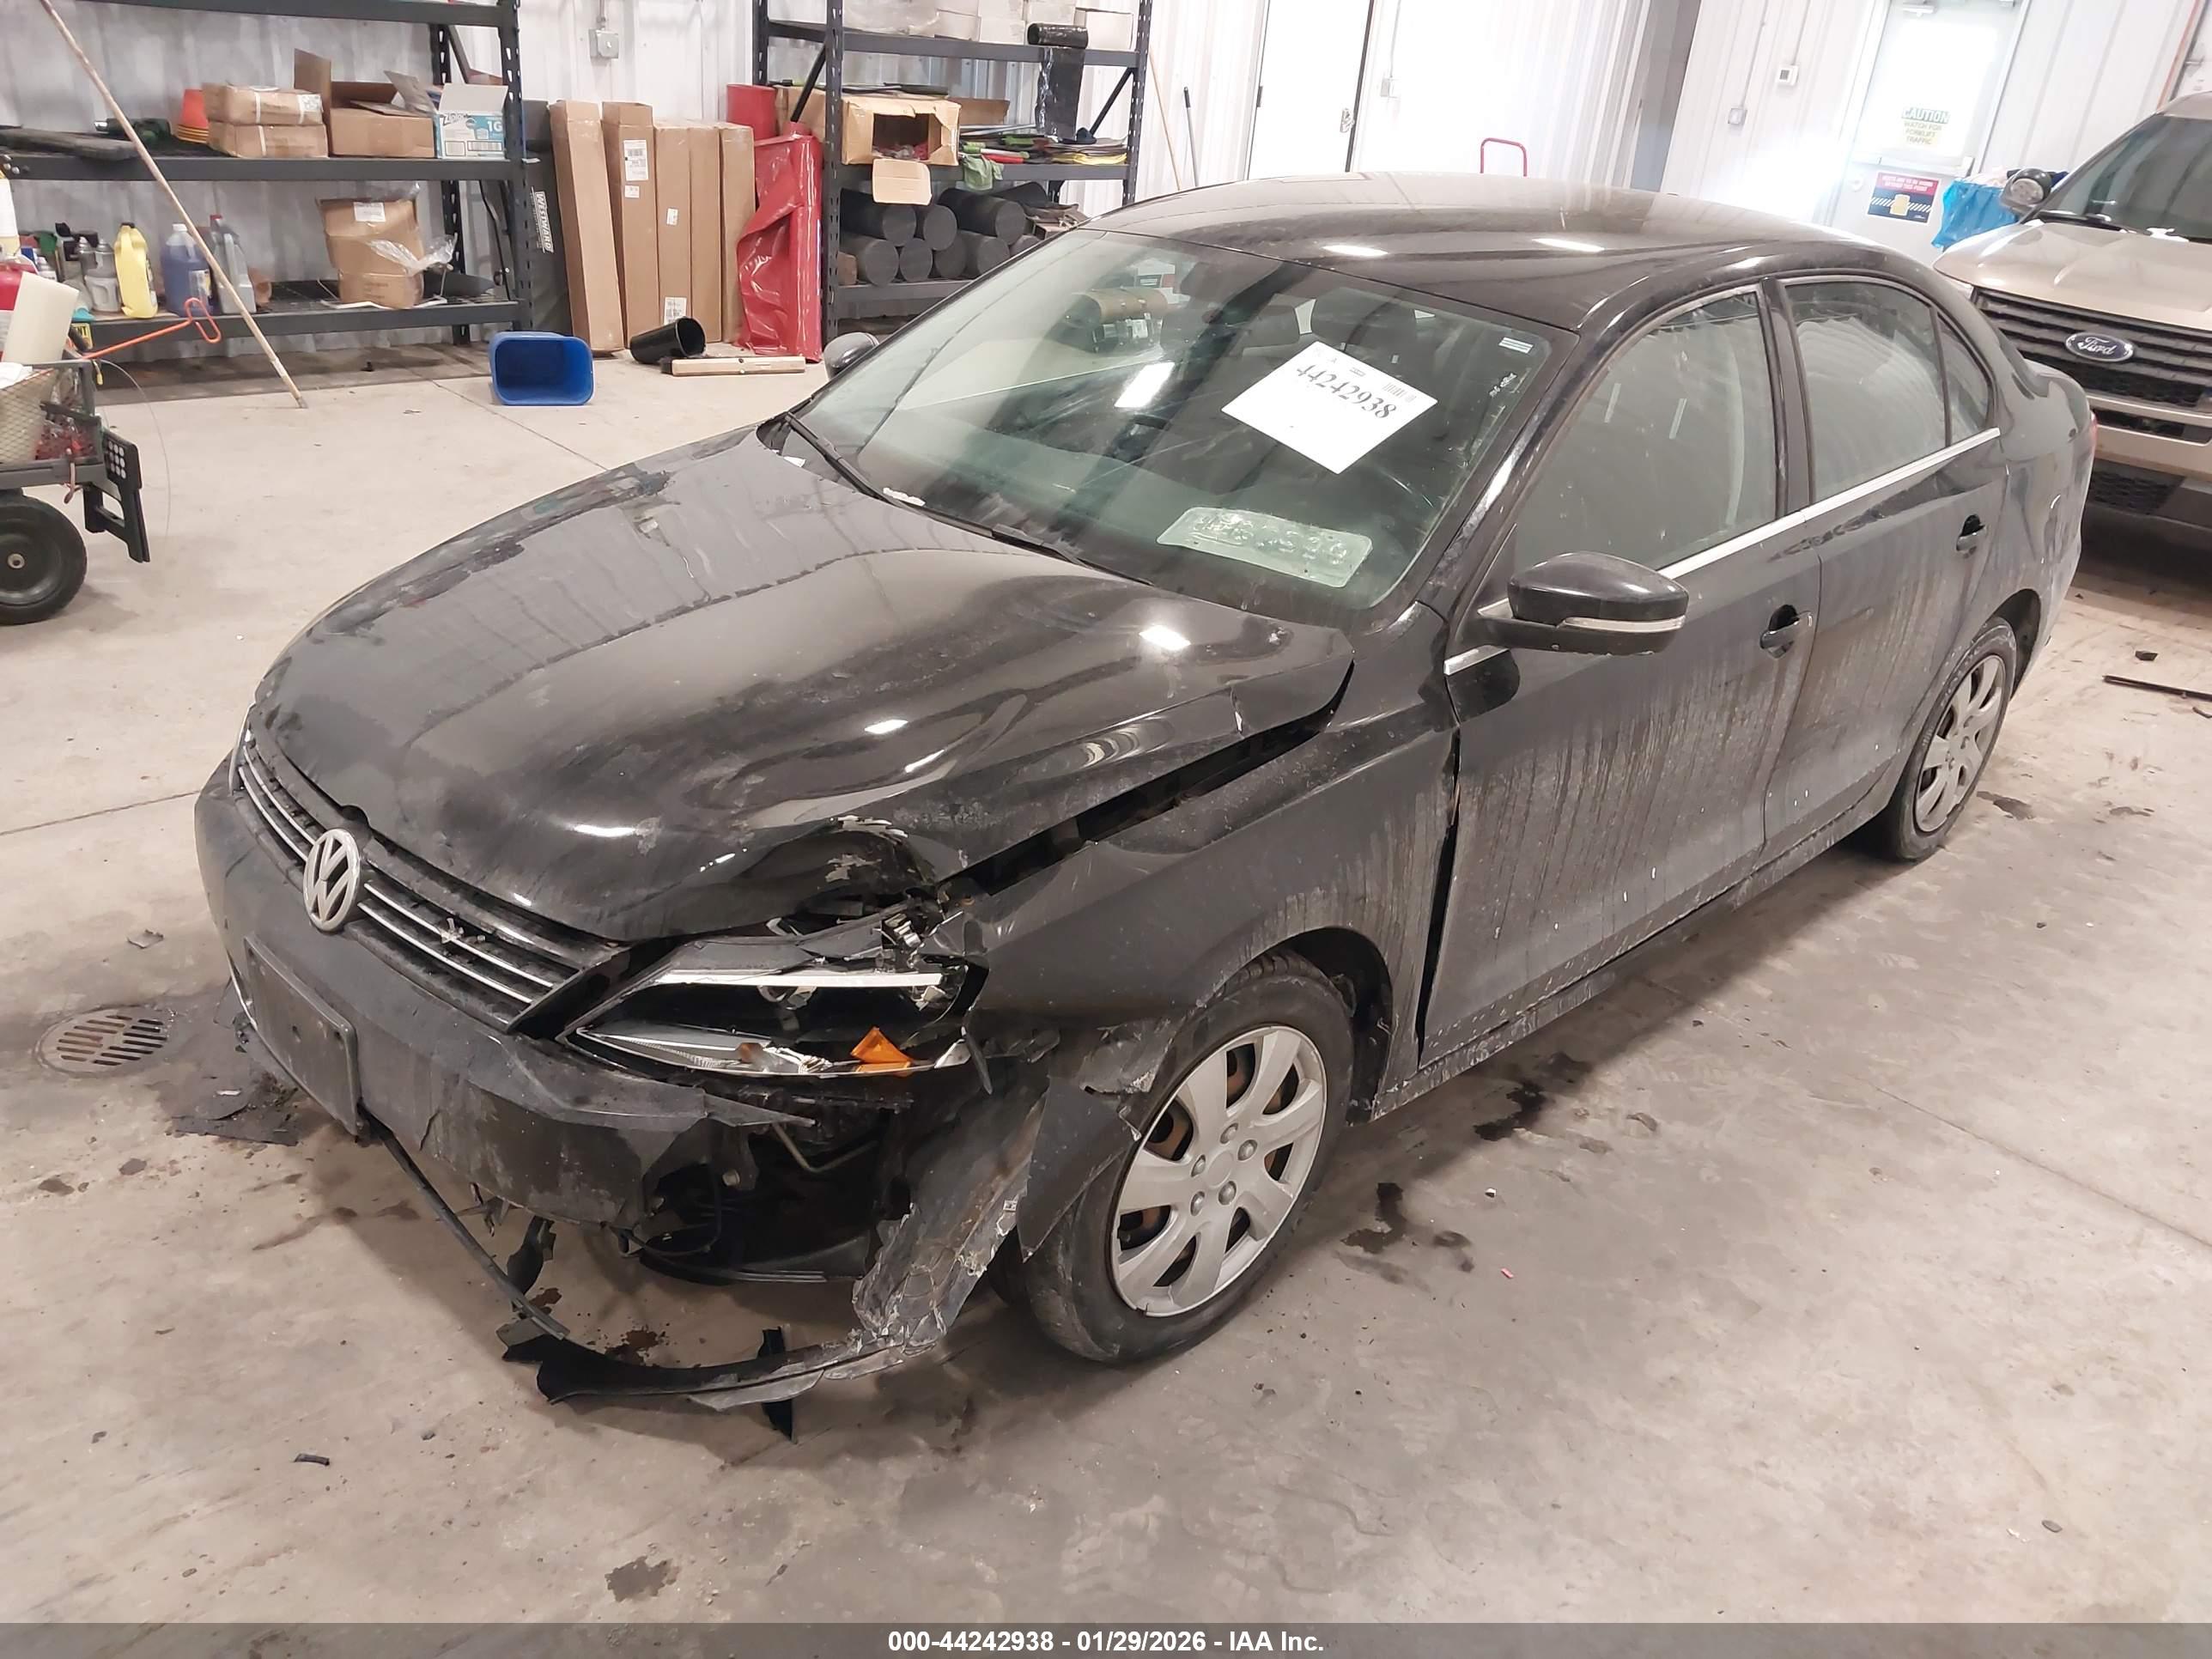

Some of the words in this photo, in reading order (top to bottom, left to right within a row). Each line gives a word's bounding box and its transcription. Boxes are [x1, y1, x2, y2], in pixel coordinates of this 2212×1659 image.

[1901, 107, 1950, 124] CAUTION
[535, 191, 553, 252] WESTWARD
[2078, 337, 2118, 355] Ford
[1297, 365, 1397, 418] 44242938
